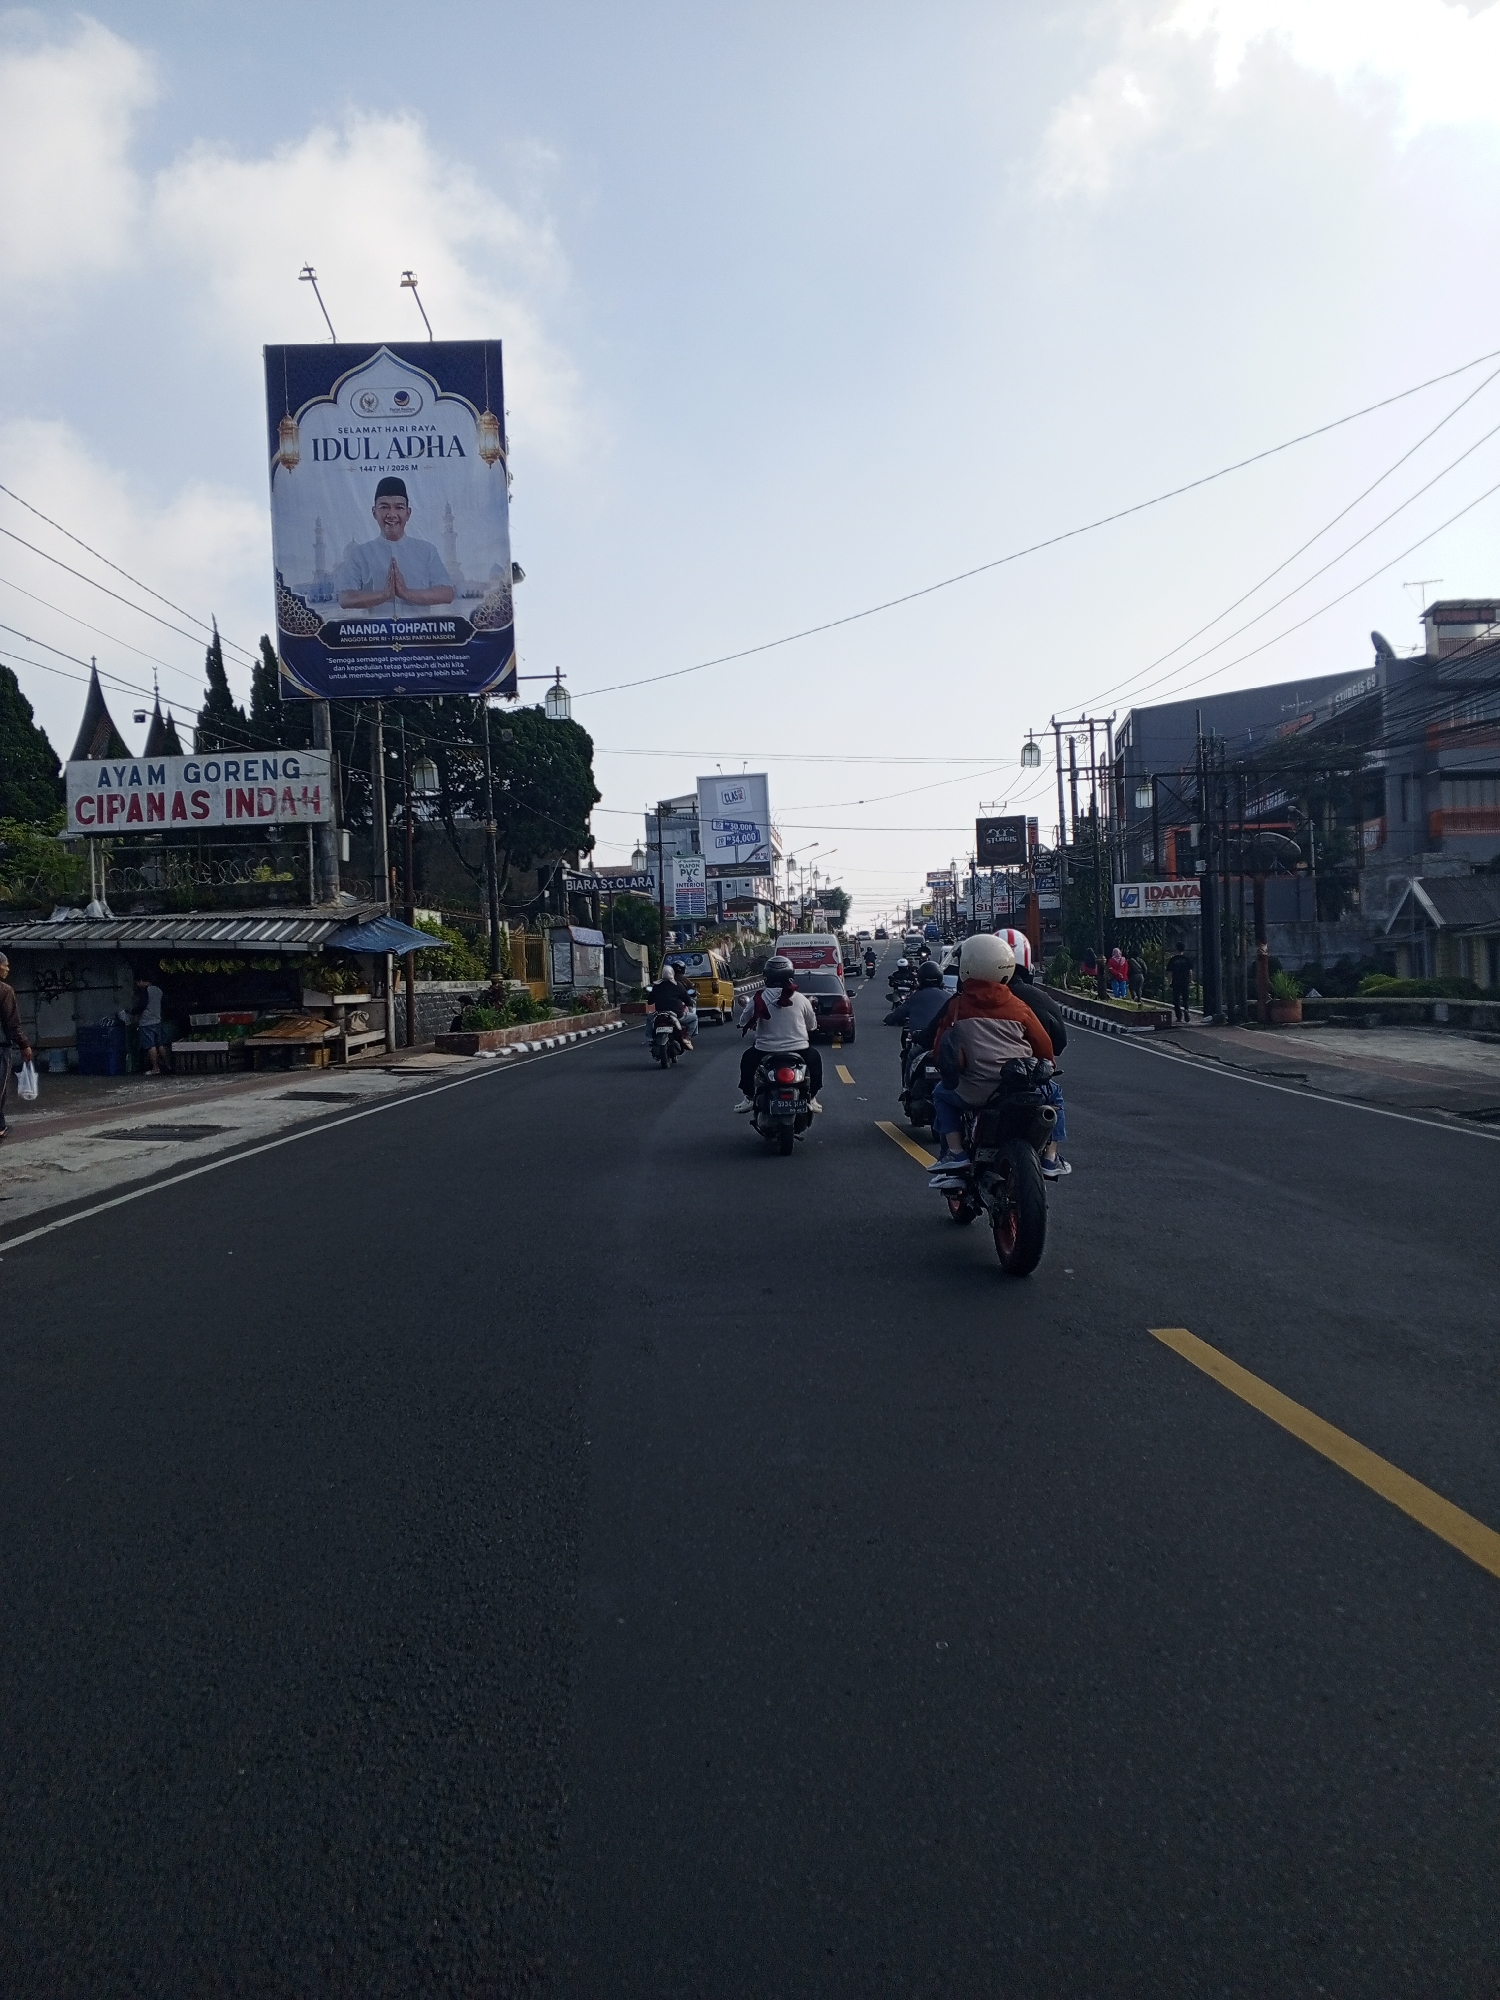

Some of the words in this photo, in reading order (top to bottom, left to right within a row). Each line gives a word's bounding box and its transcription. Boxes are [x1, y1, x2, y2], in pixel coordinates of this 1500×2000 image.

[338, 426, 382, 434] SELAMAT
[385, 425, 408, 433] HARI
[312, 436, 380, 462] IDUL
[386, 434, 467, 460] ADHA
[339, 624, 388, 635] ANANDA
[390, 622, 437, 633] TOHPATI
[440, 622, 456, 632] NR
[97, 762, 166, 788] AYAM
[183, 757, 300, 784] GORENG
[74, 789, 211, 825] CIPANAS
[225, 785, 322, 818] INDAH
[986, 836, 1017, 844] STURGIS
